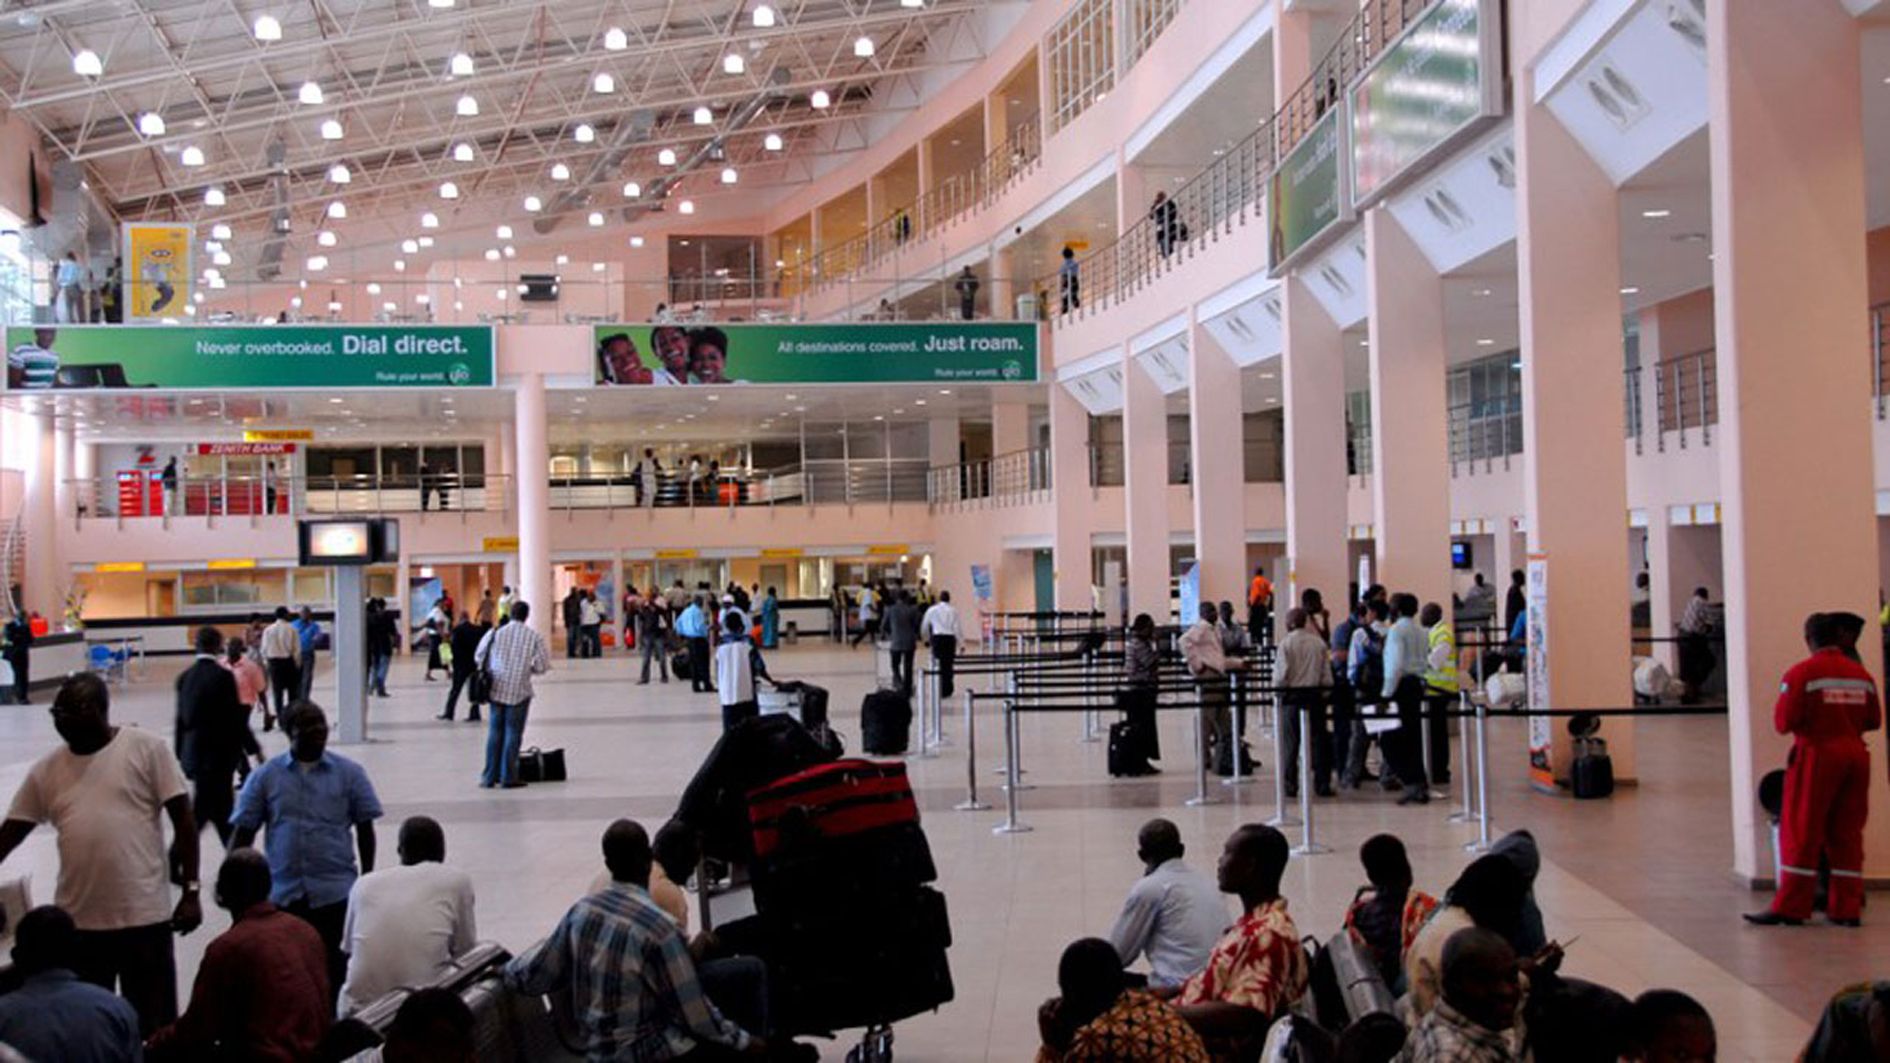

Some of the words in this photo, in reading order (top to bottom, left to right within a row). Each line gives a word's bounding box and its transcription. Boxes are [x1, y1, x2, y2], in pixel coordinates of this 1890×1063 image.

[196, 340, 241, 354] Never
[245, 340, 335, 354] overbooked.
[342, 335, 387, 354] Dial
[394, 335, 468, 354] direct.
[778, 341, 793, 353] All
[795, 341, 866, 353] destinations
[868, 341, 919, 353] covered.
[924, 335, 966, 352] Just
[970, 337, 1023, 351] roam.
[210, 443, 250, 454] ZENITH
[252, 443, 284, 454] BANK
